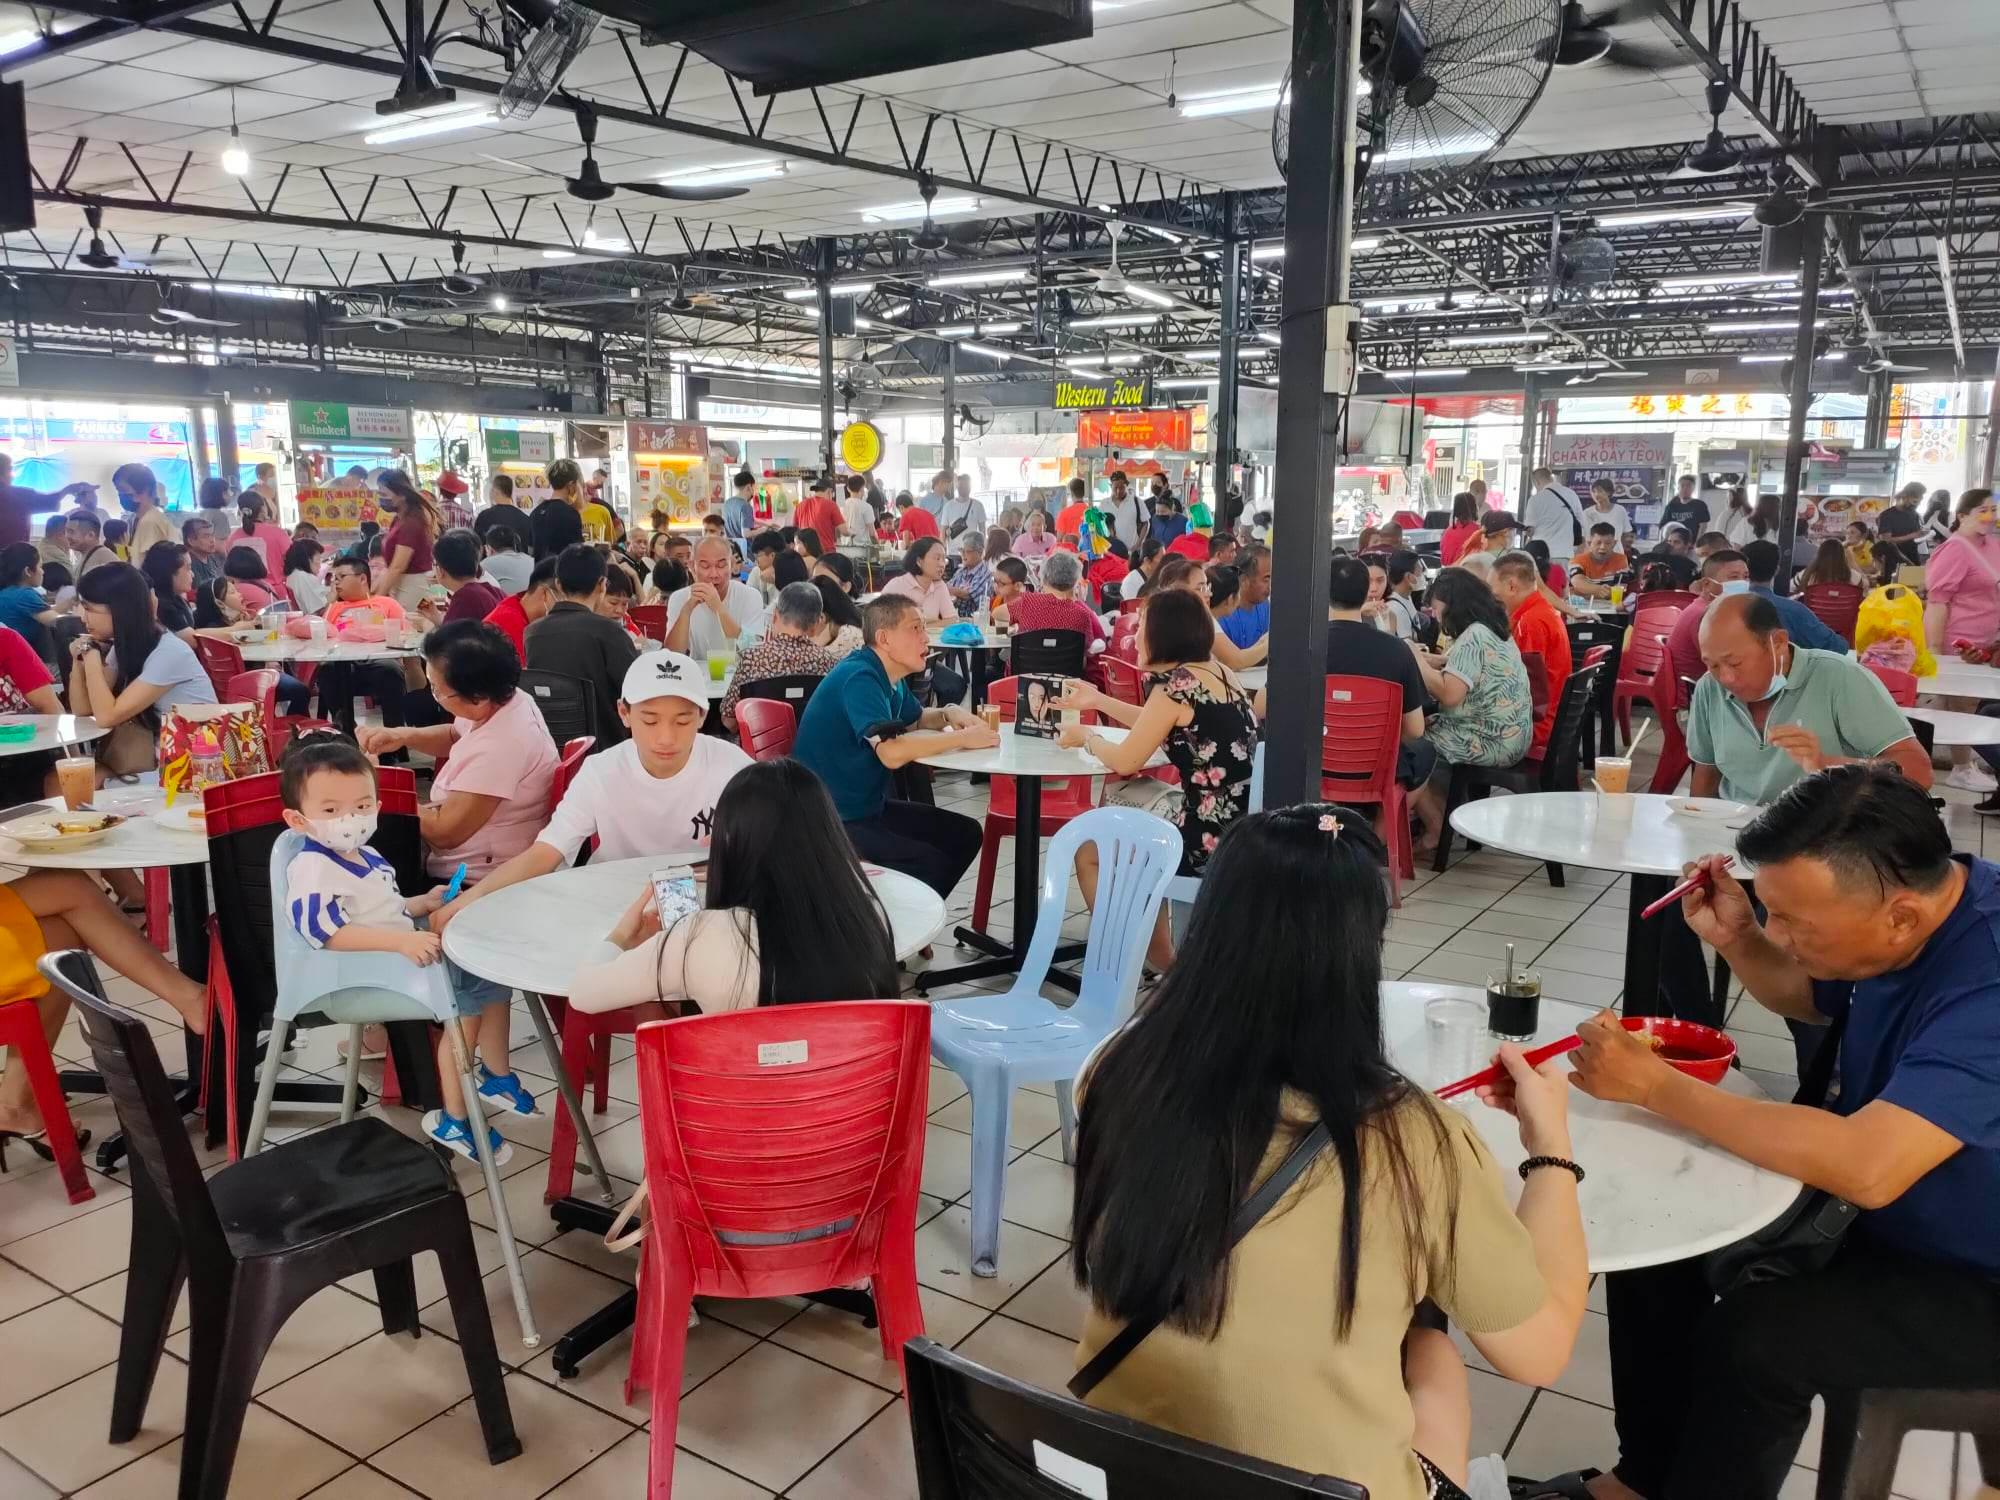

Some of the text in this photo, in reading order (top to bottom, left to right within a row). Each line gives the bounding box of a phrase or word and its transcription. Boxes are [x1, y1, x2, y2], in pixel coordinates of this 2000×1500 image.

[1056, 380, 1145, 407] Western Food
[299, 423, 346, 436] Heineken
[1553, 449, 1665, 464] CHAR KOAY TEOW
[656, 673, 682, 681] adidas
[691, 806, 716, 840] NY
